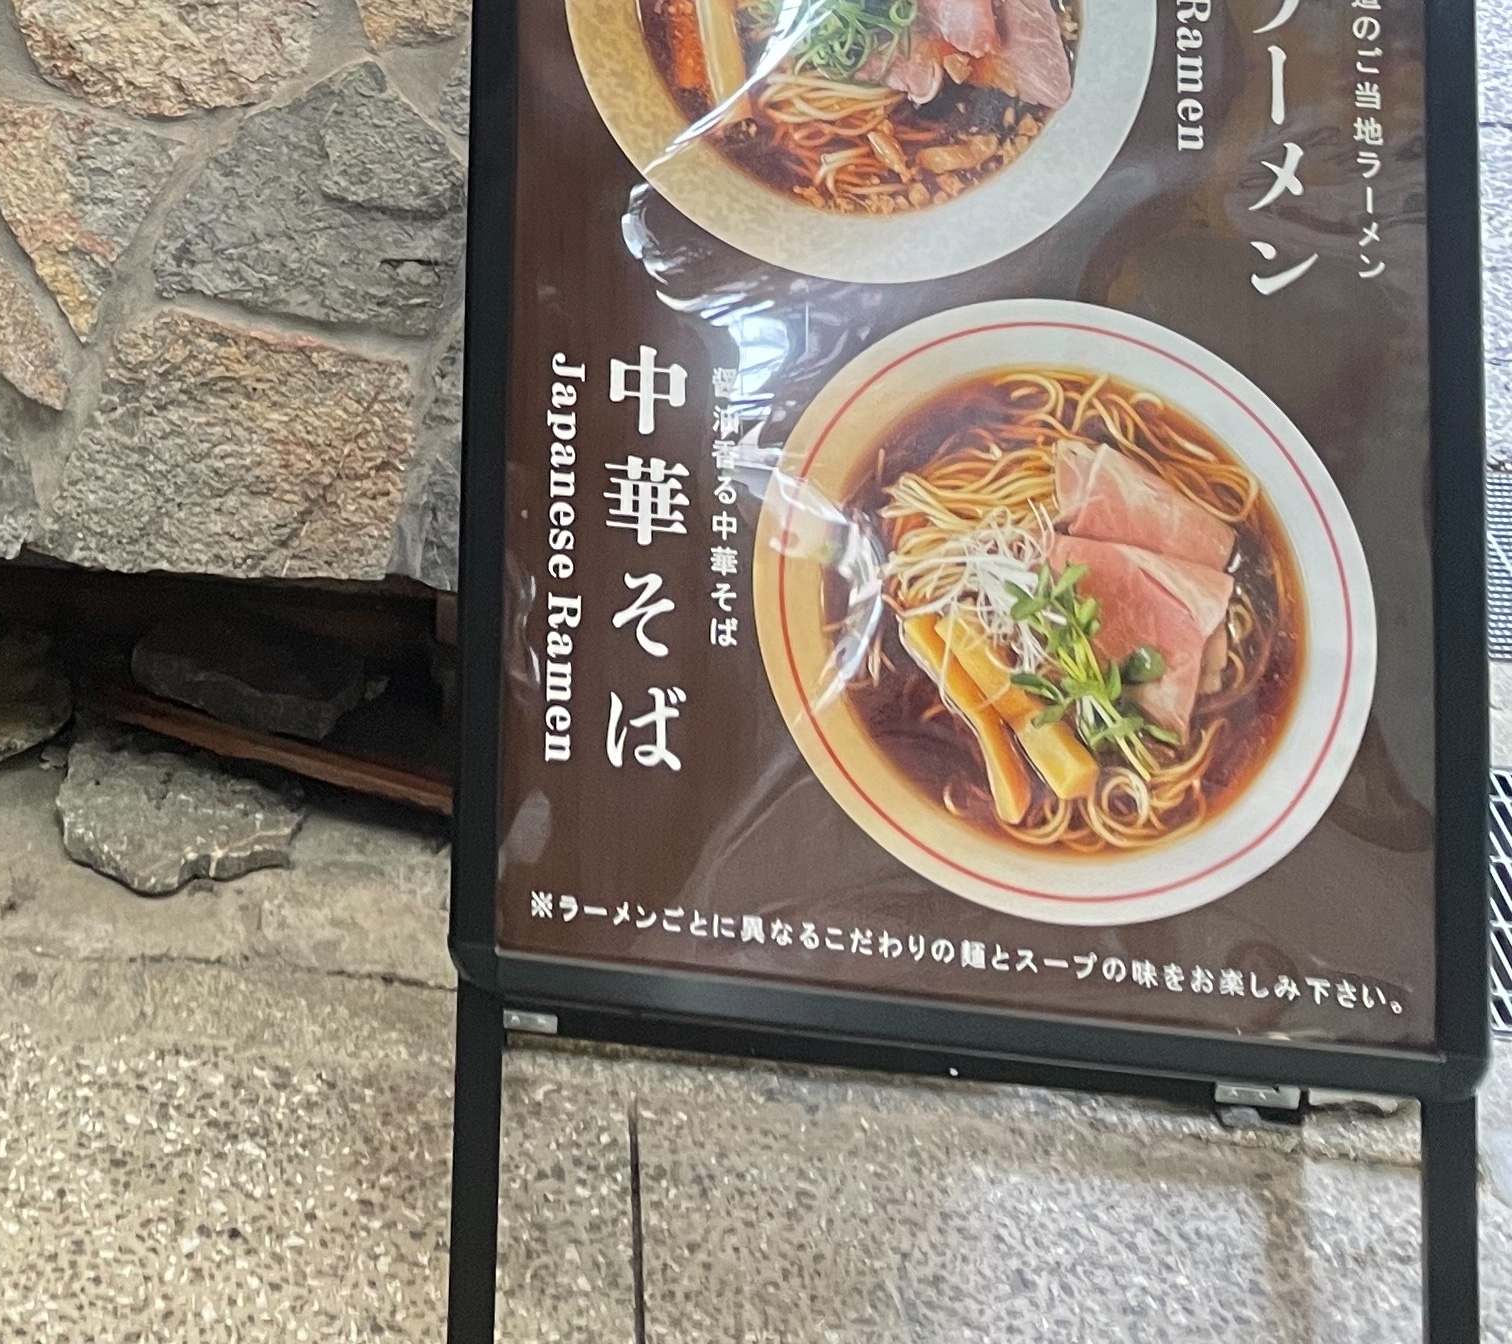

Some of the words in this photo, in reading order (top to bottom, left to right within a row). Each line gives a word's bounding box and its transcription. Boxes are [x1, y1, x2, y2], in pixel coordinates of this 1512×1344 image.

[547, 353, 586, 580] Japanese
[603, 345, 689, 772] 中華そば
[543, 594, 583, 762] Ramen
